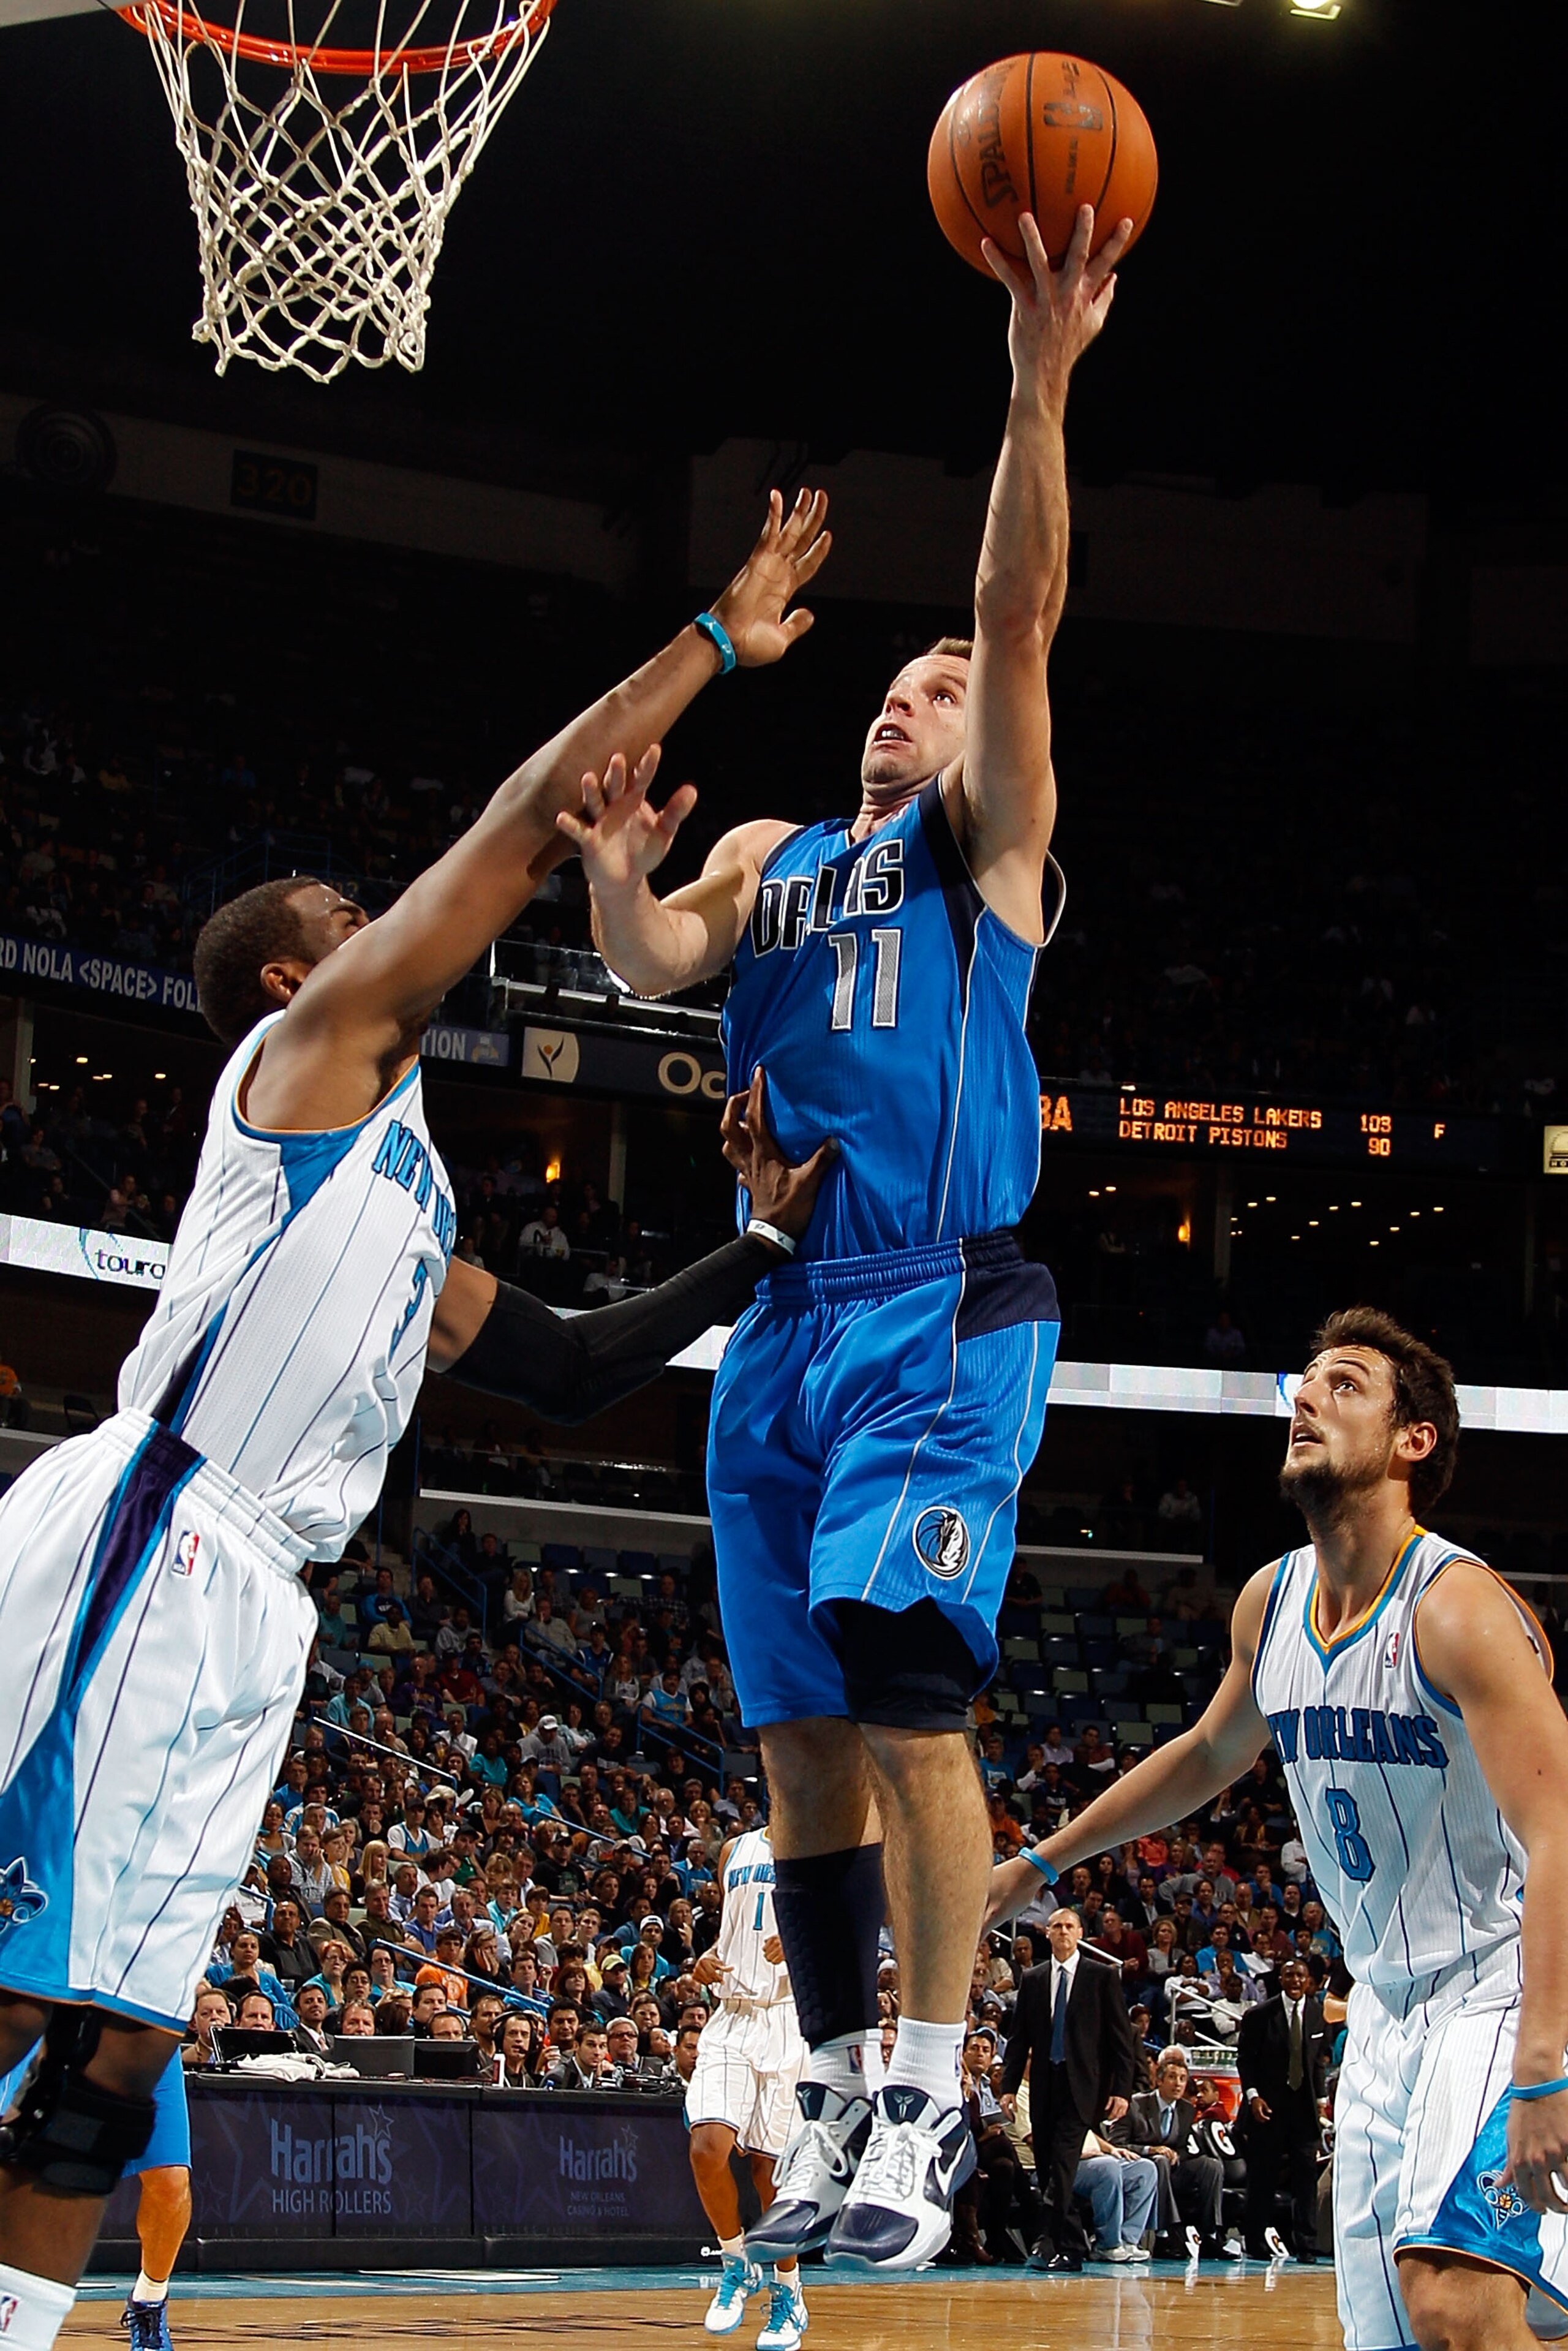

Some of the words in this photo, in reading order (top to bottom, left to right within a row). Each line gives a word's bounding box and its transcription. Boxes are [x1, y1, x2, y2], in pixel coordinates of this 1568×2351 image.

[236, 460, 312, 507] 320
[23, 942, 73, 983] NOLA
[79, 958, 157, 1000] <SPACE>
[828, 929, 901, 1030] 11
[1119, 1120, 1197, 1142] DETROIT
[1209, 1126, 1287, 1149] PISTONS
[1368, 1138, 1390, 1156] 90
[1120, 1098, 1155, 1117] LOS
[1164, 1101, 1244, 1123] ANGELES
[1254, 1107, 1322, 1129] LAKERS
[1360, 1114, 1392, 1133] 103
[1434, 1124, 1446, 1139] F
[1303, 1706, 1450, 1768] ORLEANS
[1325, 1787, 1376, 1882] 8
[753, 1892, 765, 1930] 1
[273, 2189, 314, 2214] HIGH
[319, 2189, 392, 2214] ROLLERS
